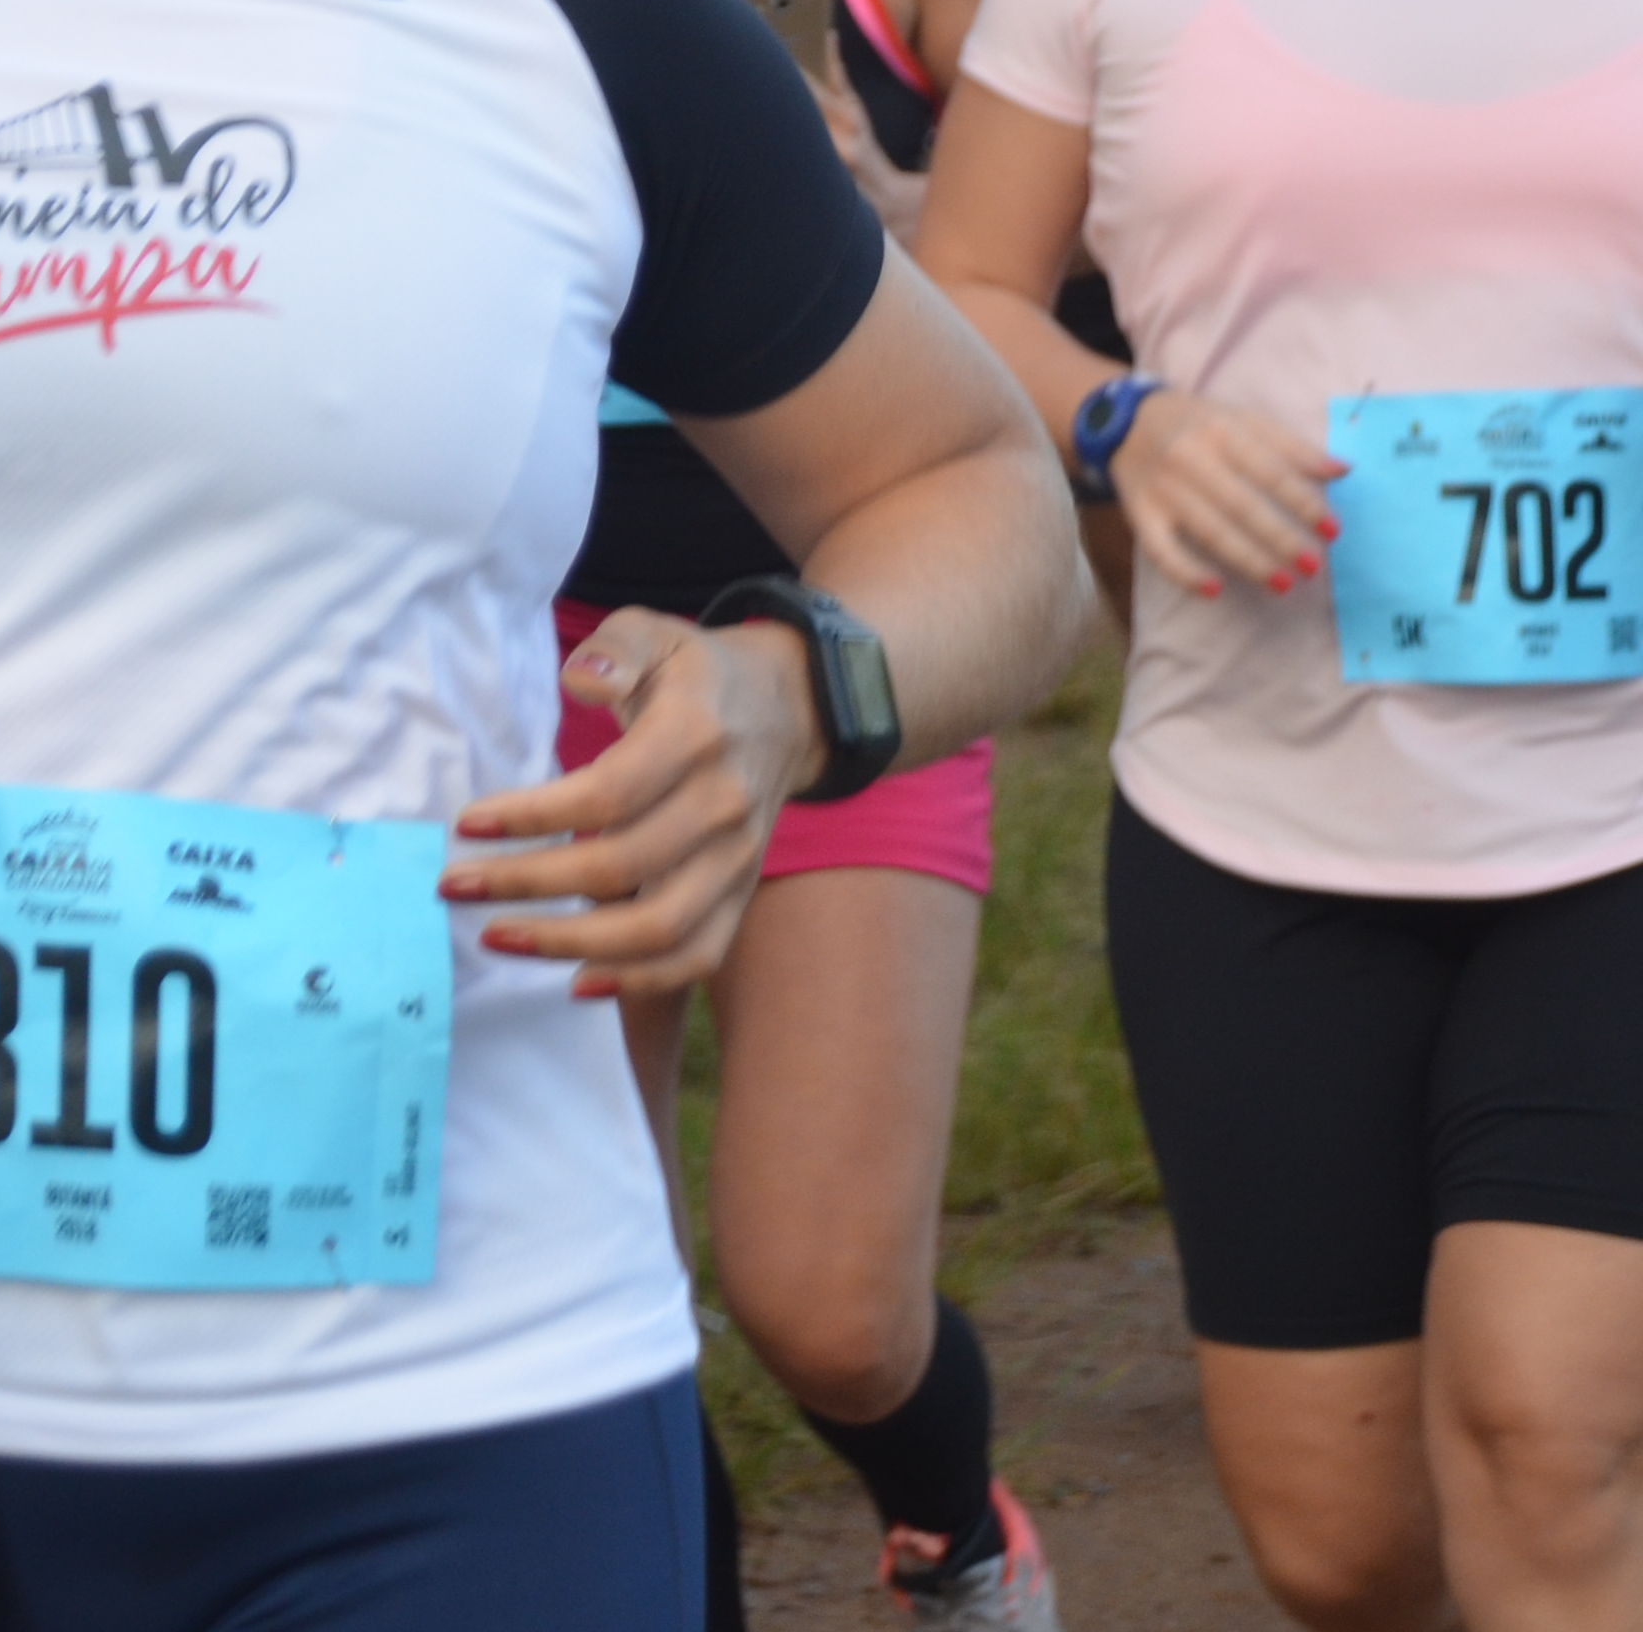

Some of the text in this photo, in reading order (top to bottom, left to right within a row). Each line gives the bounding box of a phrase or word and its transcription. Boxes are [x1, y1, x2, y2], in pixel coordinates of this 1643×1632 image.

[178, 156, 277, 236] de
[1439, 481, 1609, 606] 702
[167, 839, 256, 874] CAIXA
